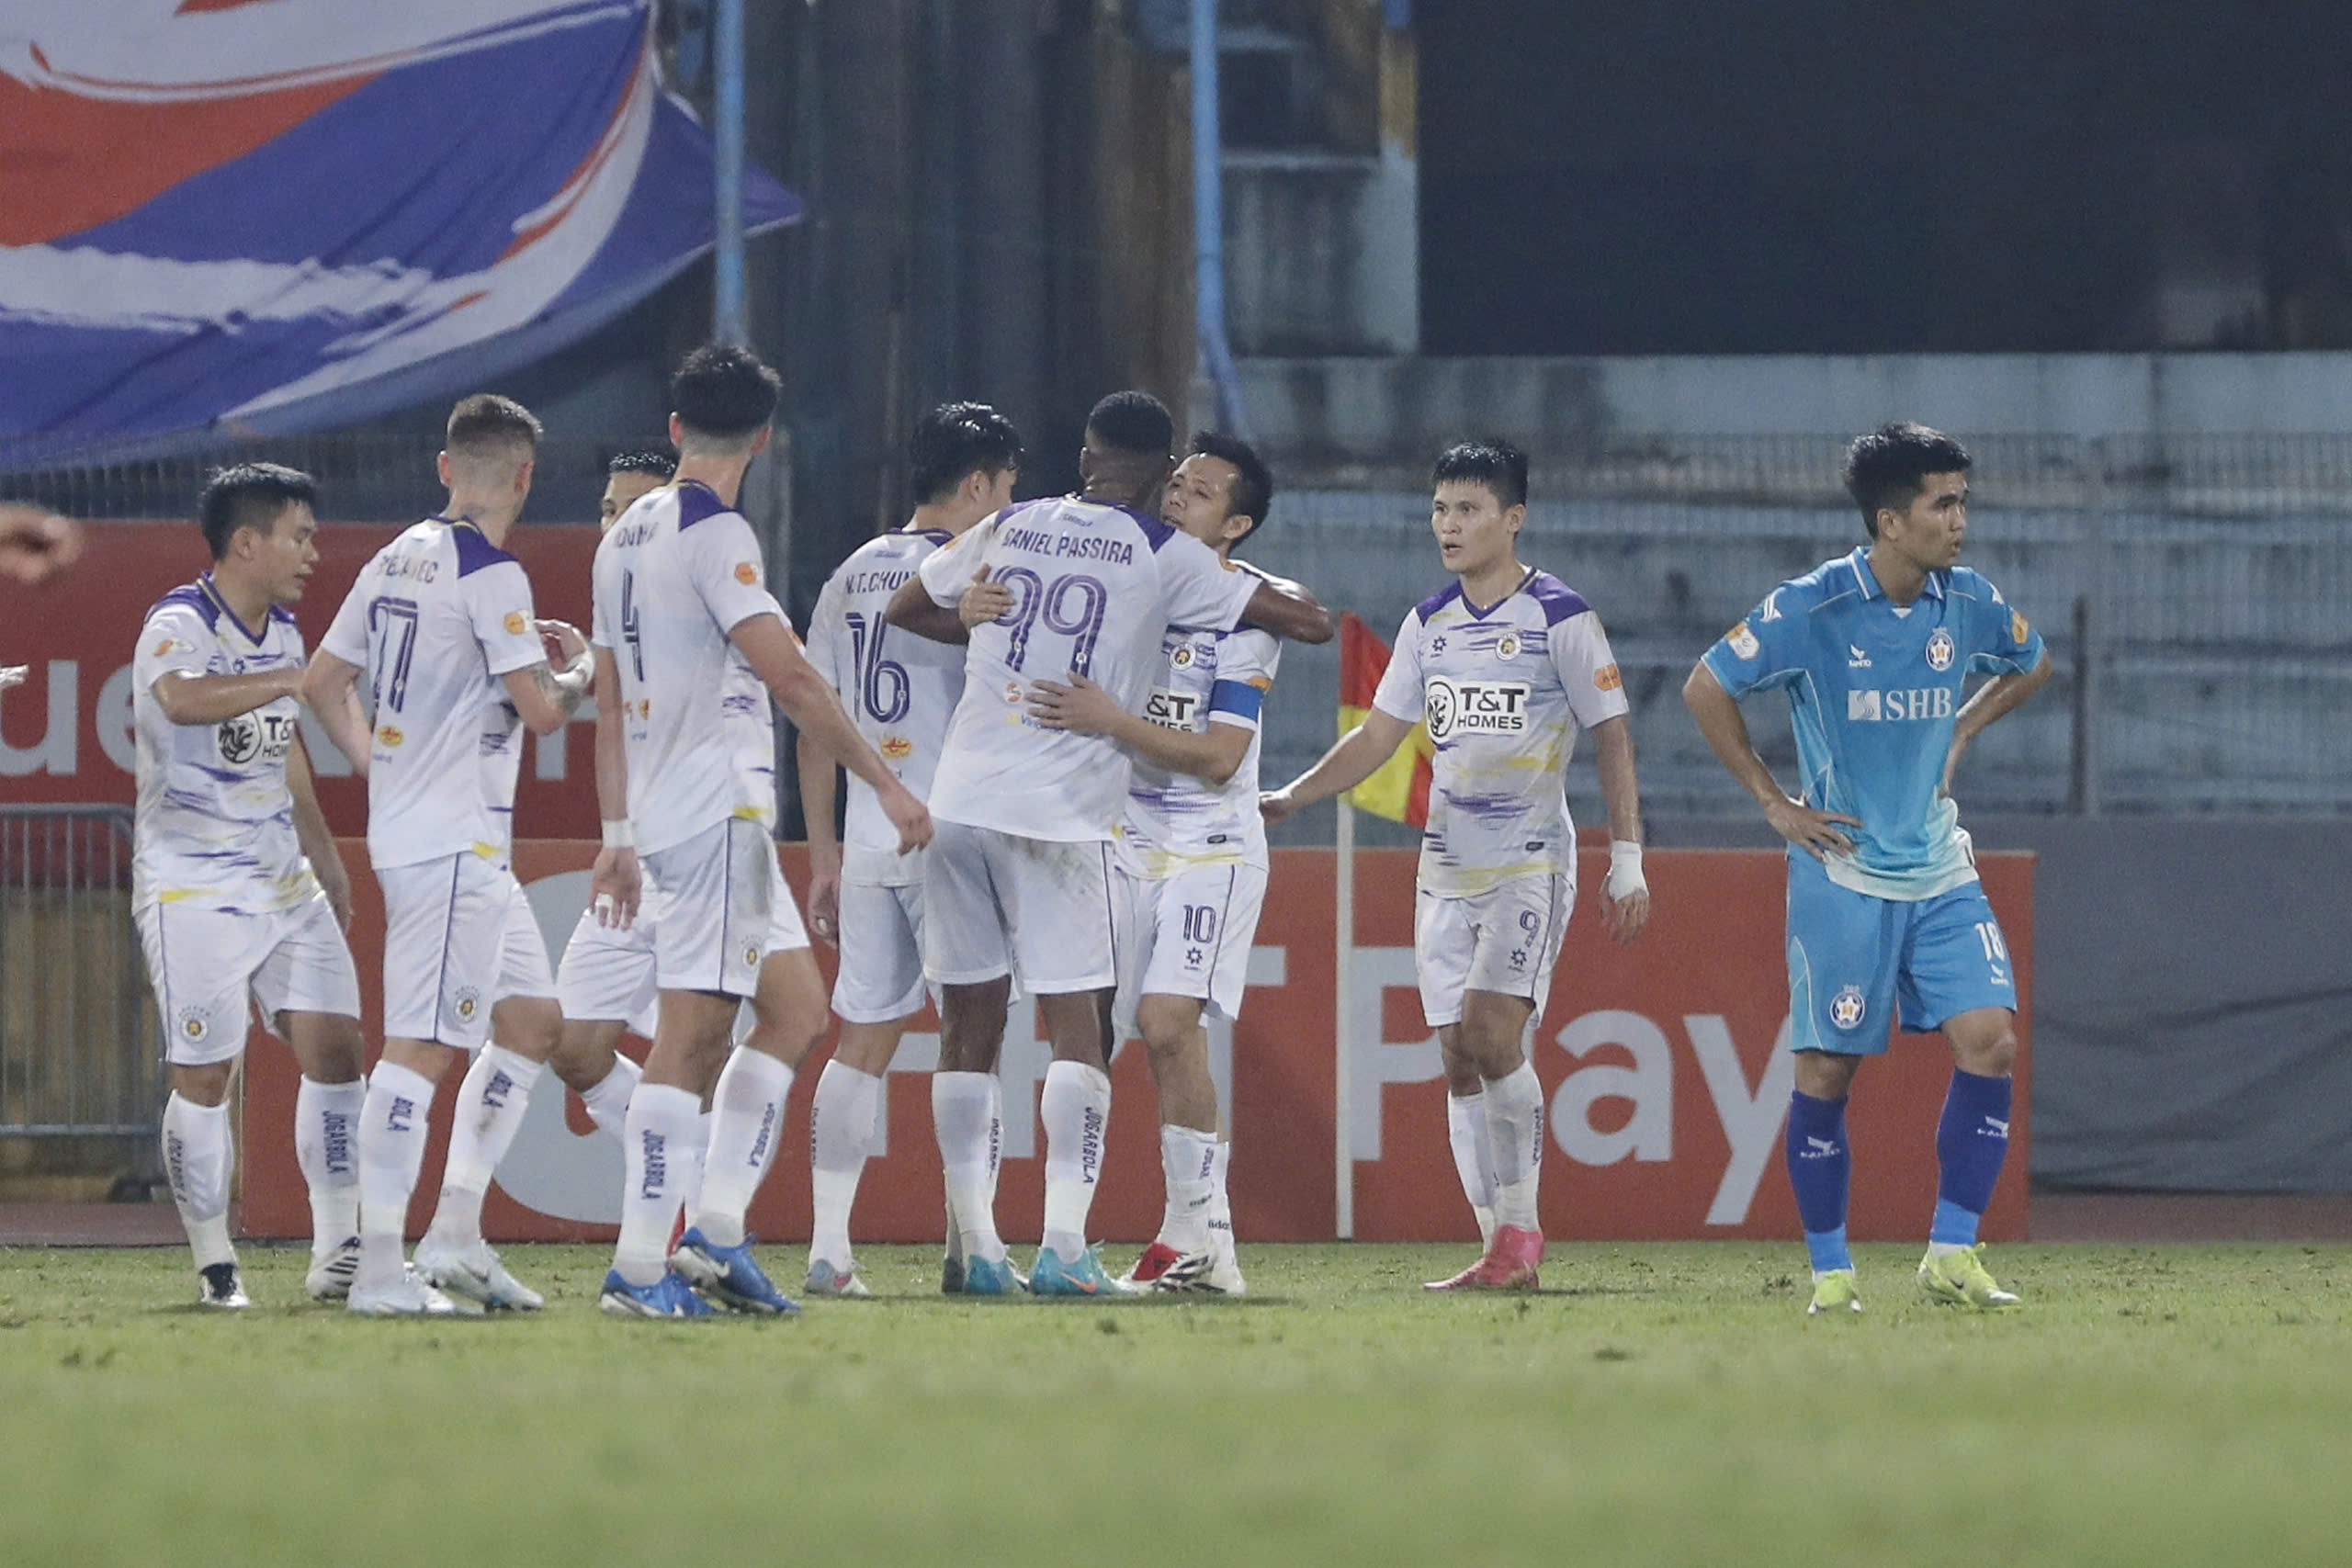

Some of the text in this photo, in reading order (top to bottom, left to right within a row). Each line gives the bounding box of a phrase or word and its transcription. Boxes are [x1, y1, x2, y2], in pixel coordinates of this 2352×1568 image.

[1057, 536, 1133, 566] PASSIRA
[993, 565, 1107, 678] 99
[845, 611, 910, 724] 16
[1147, 694, 1194, 720] &T
[1460, 687, 1525, 713] T&T
[1885, 686, 1952, 721] SHB
[1457, 715, 1523, 730] HOMES
[1183, 904, 1216, 944] 10
[1520, 909, 1541, 948] 9
[1350, 946, 1792, 1224] Pay
[1082, 1105, 1102, 1184] JOGARBOLA
